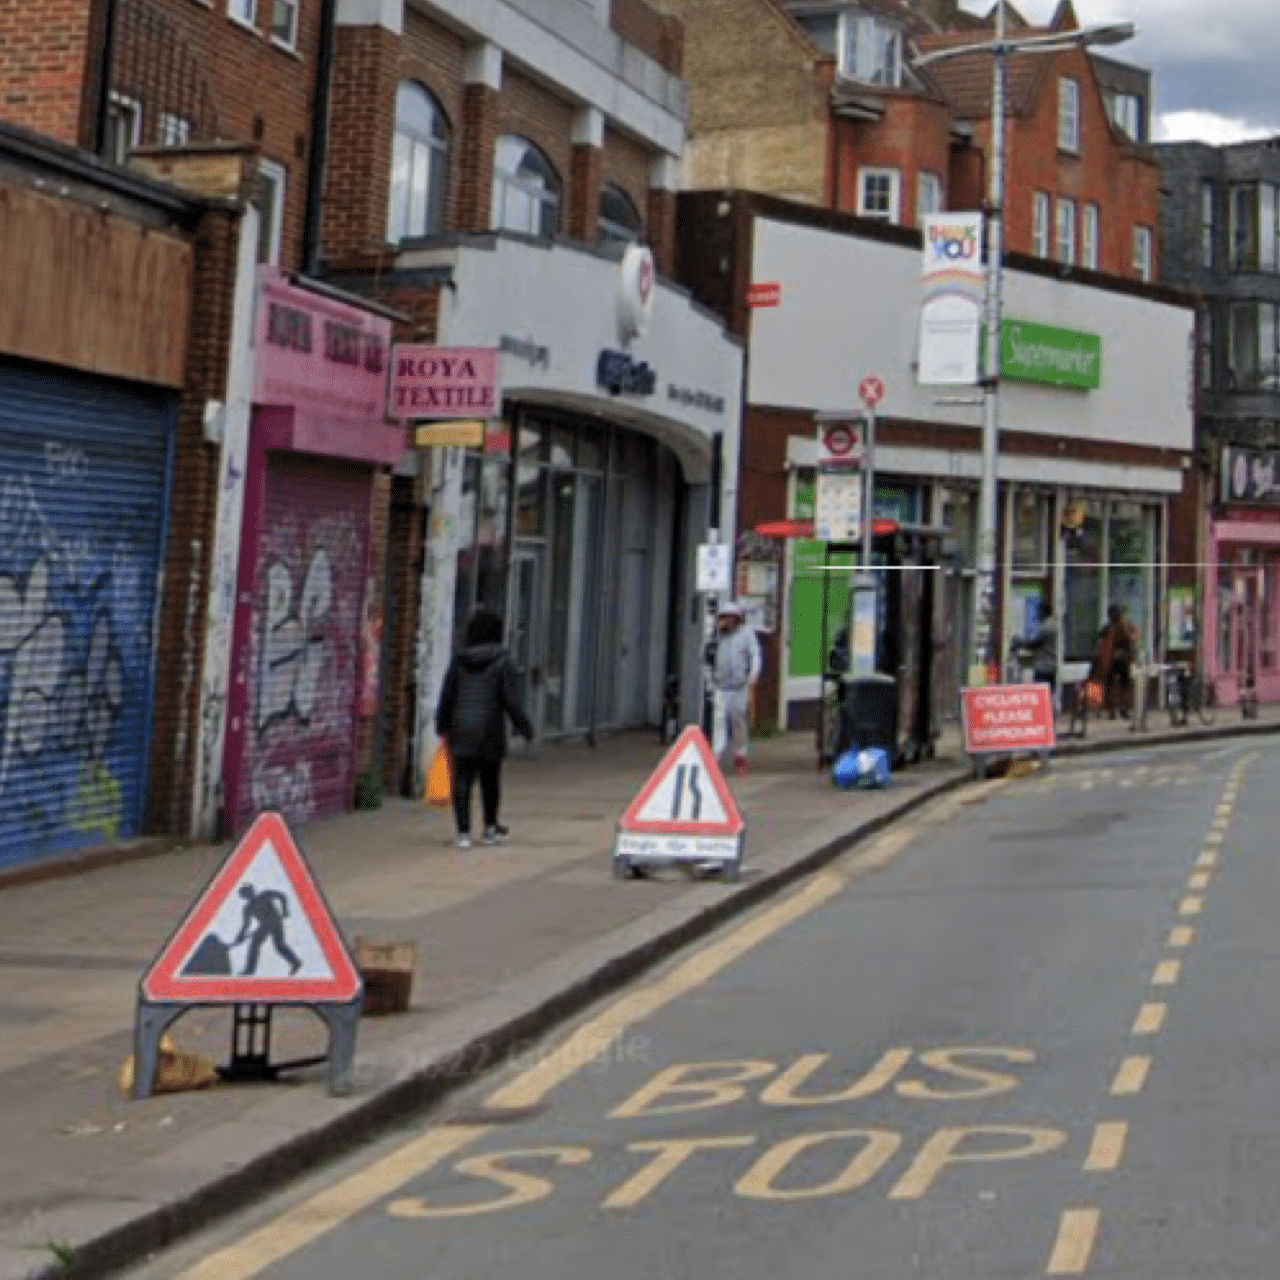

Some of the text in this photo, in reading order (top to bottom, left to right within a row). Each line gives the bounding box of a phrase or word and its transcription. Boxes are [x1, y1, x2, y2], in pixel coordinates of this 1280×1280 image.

[396, 357, 476, 378] ROYA
[394, 385, 495, 408] TEXTILE
[606, 1045, 1036, 1119] BUS
[387, 1127, 1068, 1218] STOP
